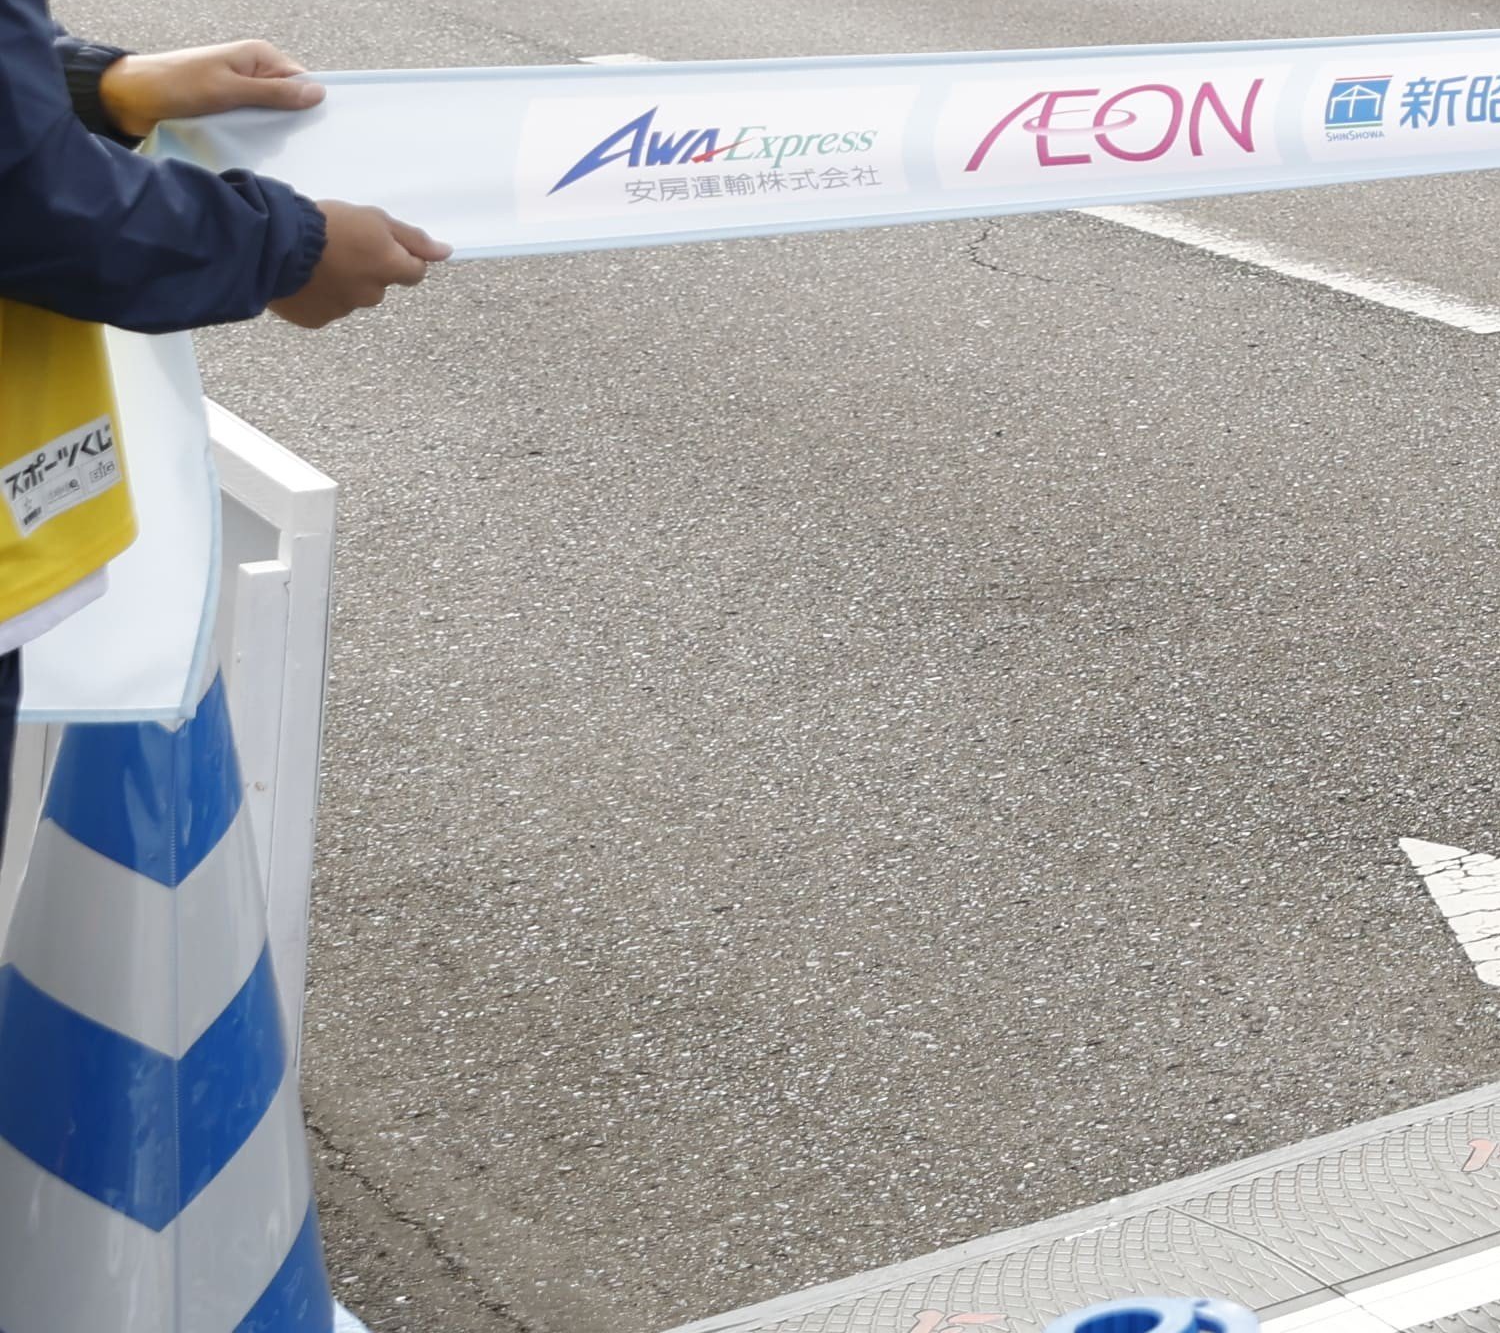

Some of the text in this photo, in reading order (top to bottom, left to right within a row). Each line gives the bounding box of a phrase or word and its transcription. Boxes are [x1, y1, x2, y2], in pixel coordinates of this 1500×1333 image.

[725, 126, 876, 171] Express
[625, 164, 882, 204] 安房運輸株式会社
[5, 424, 113, 501] スポーツくじ
